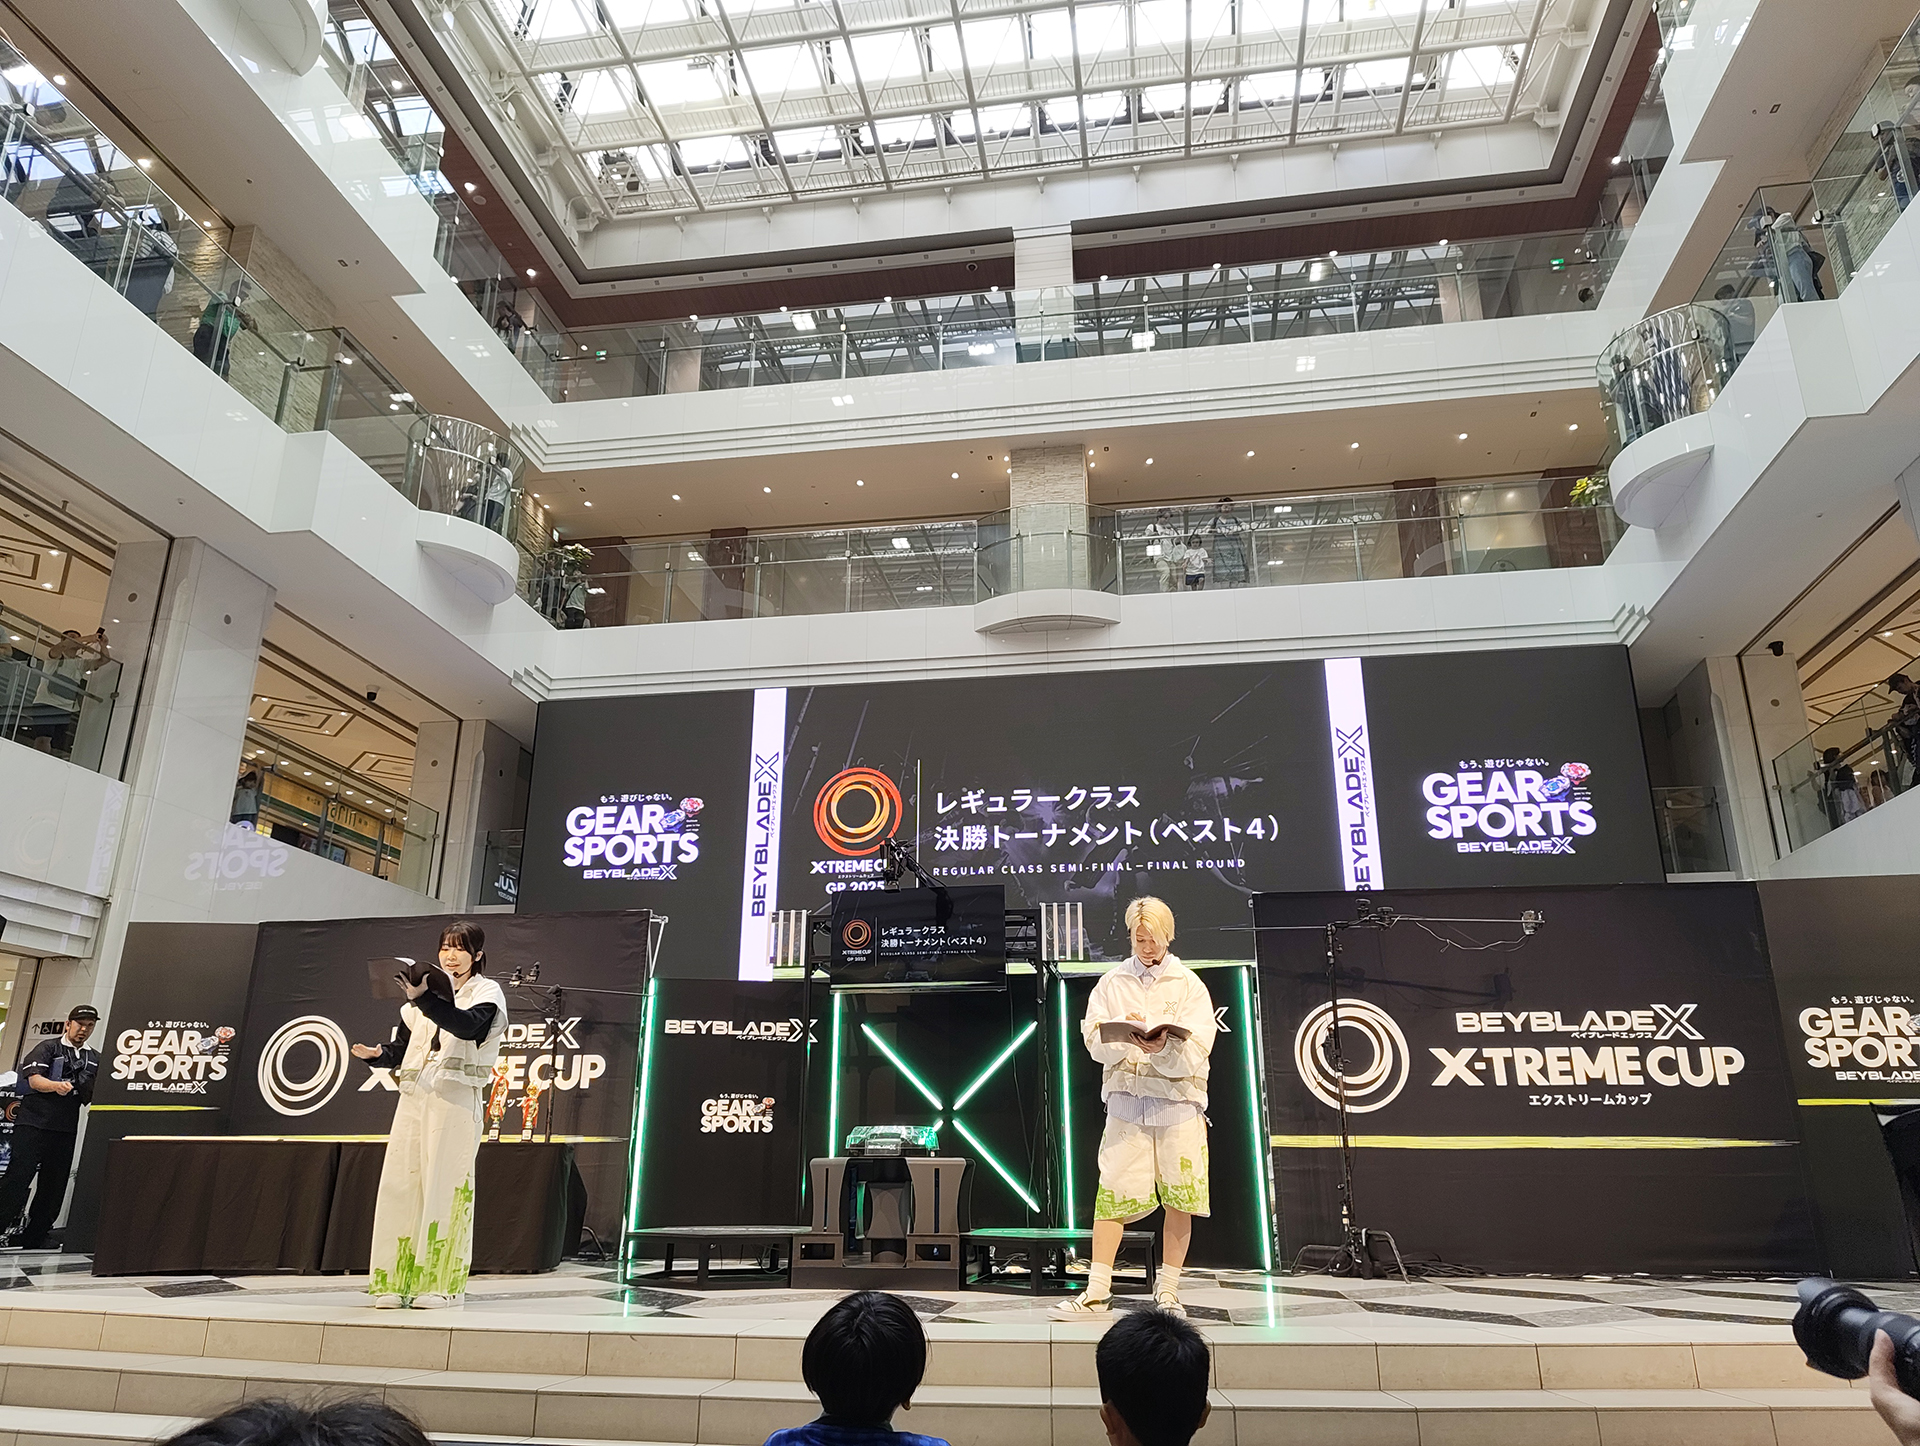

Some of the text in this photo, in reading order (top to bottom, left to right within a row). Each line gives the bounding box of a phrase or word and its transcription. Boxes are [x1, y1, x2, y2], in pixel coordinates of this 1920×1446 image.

[1459, 757, 1549, 769] もう、遊びじゃない。
[936, 785, 1140, 814] レギュラークラス
[1422, 770, 1547, 806] GEAR
[566, 804, 664, 836] GEAR
[1426, 801, 1597, 839] SPORTS
[562, 832, 699, 867] SPORTS
[933, 866, 995, 876] REGULAR
[1001, 864, 1044, 874] CLASS
[1196, 858, 1246, 869] ROUND
[881, 926, 946, 936] レギュラークラス
[1570, 1031, 1653, 1039] ベイブレードエックス
[1799, 1006, 1916, 1038] GEAR
[116, 1029, 201, 1055] GEAR
[1804, 1036, 1920, 1068] SPOR
[110, 1054, 229, 1081] SPORTS
[1428, 1045, 1745, 1087] X-TREME CUP
[701, 1099, 755, 1116] GEAR
[1528, 1092, 1653, 1106] エクストリームカップ
[700, 1116, 774, 1133] SPORTS
